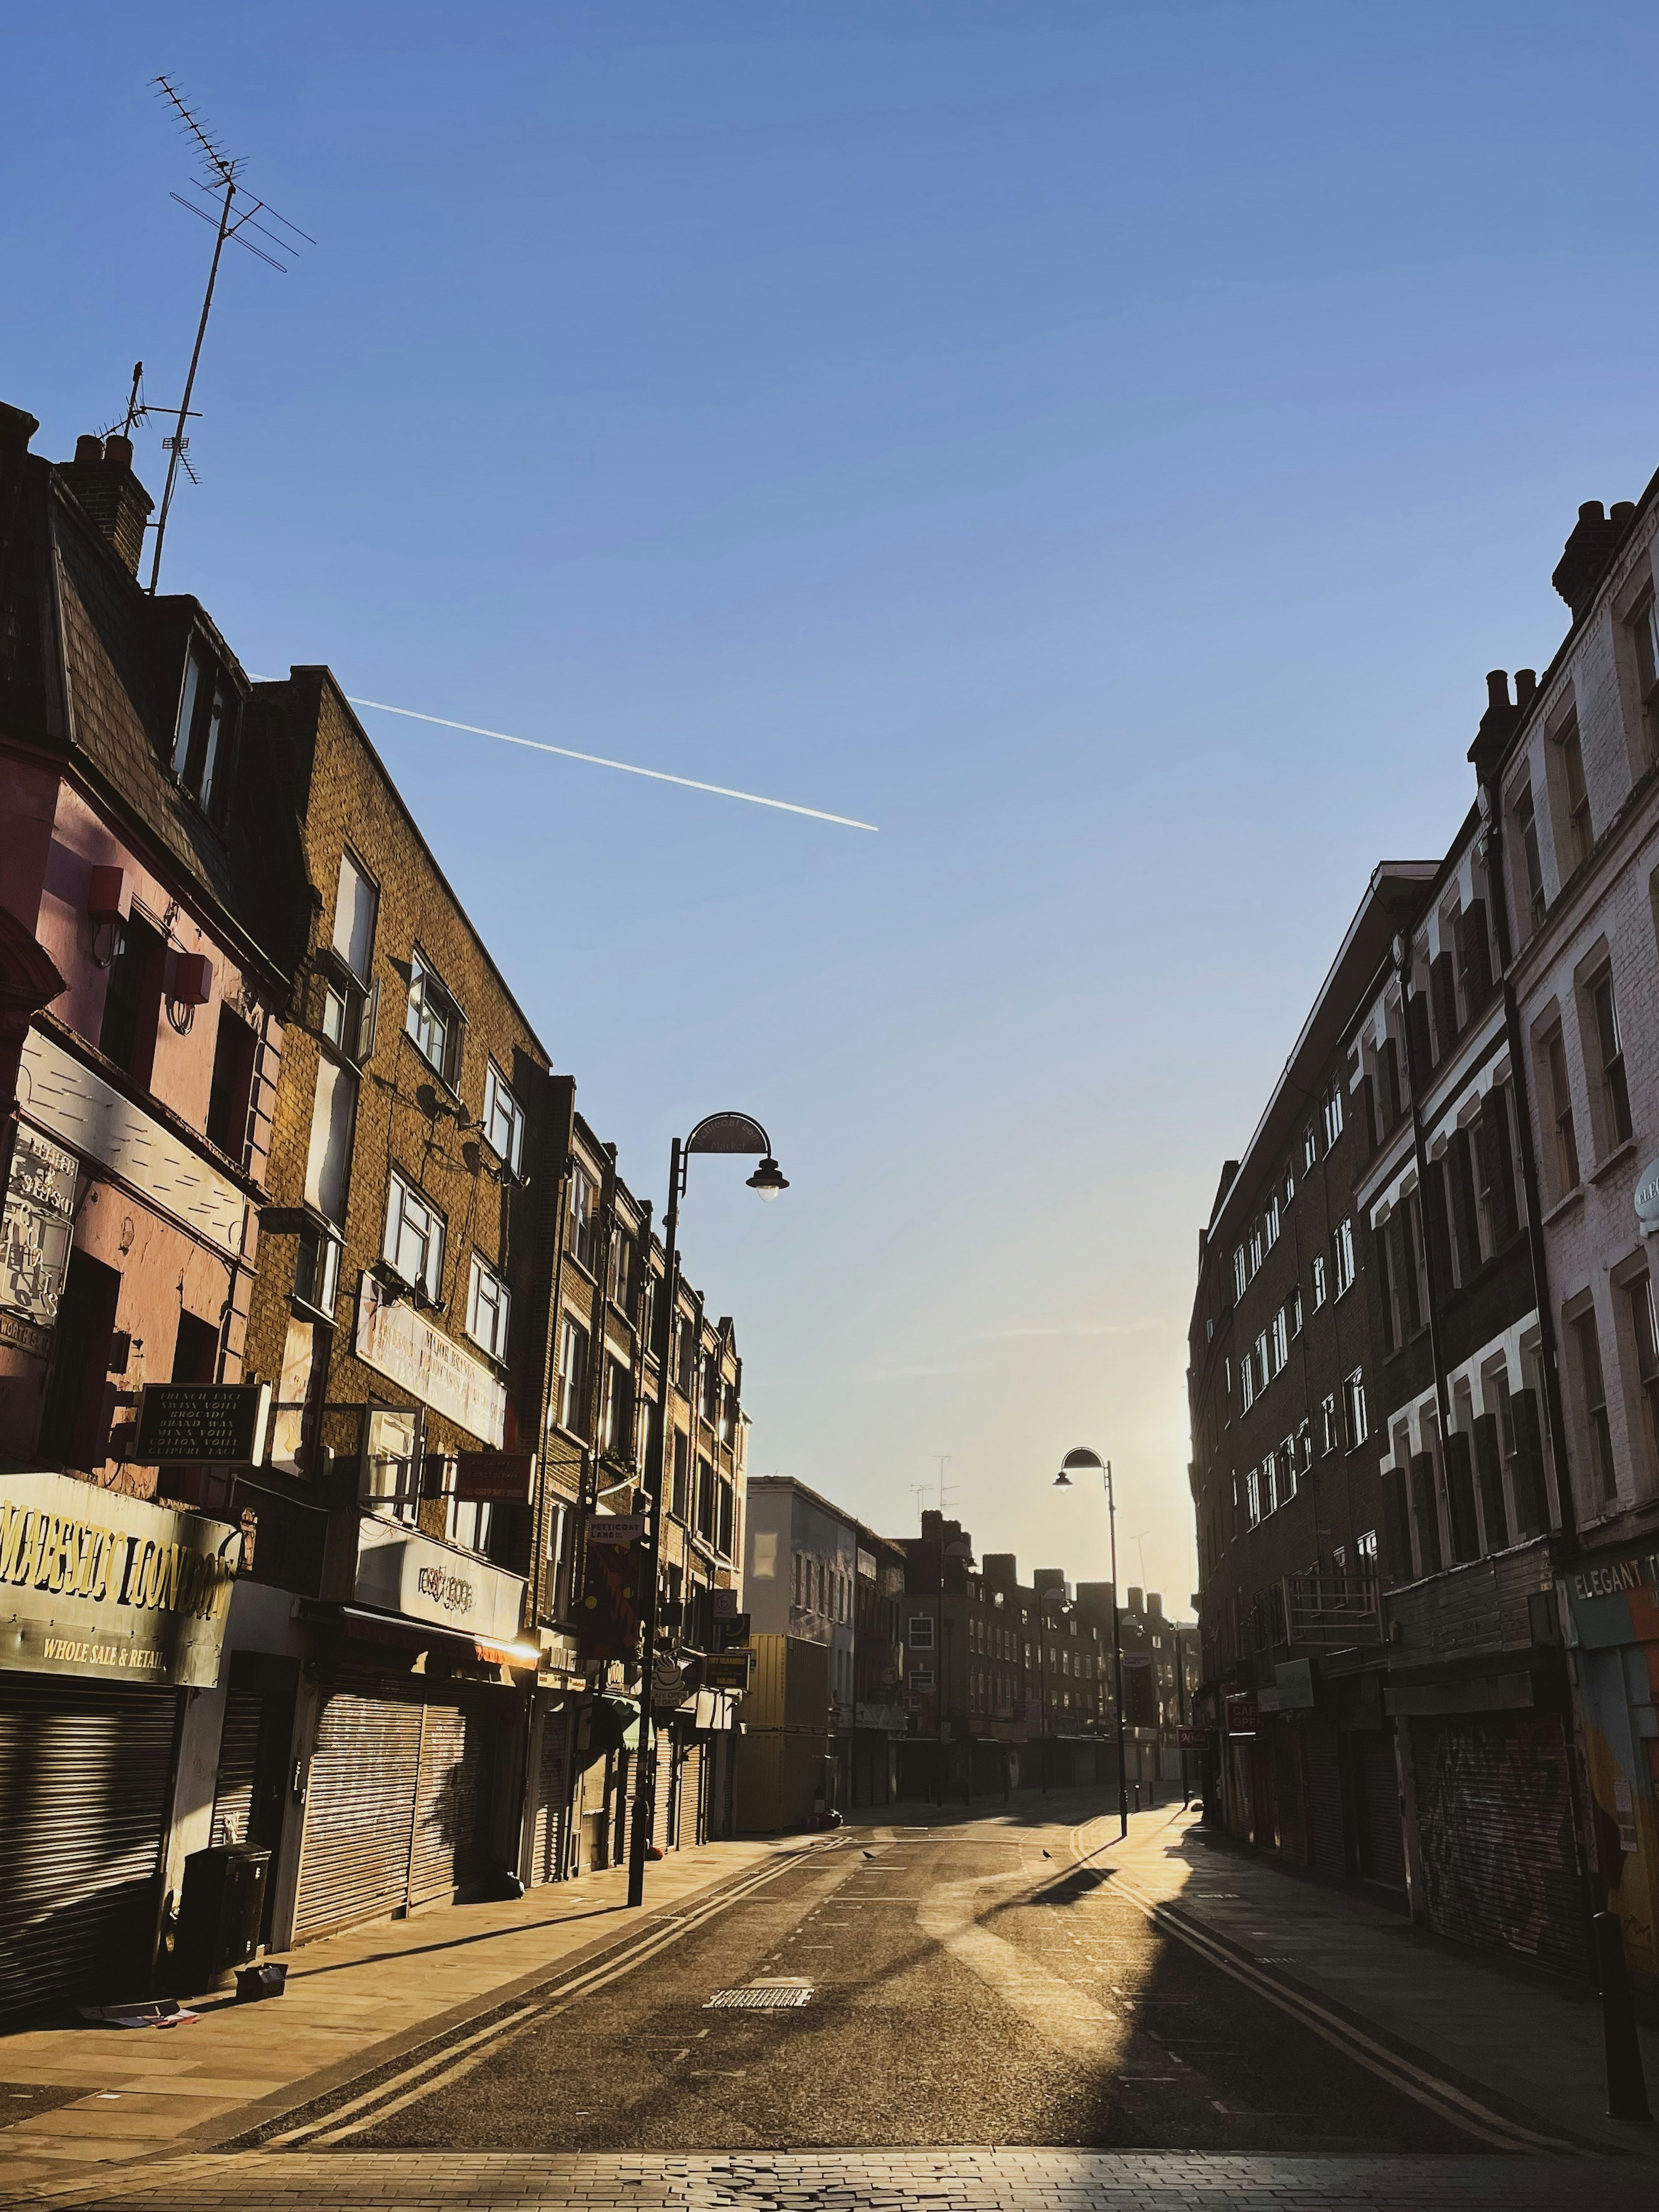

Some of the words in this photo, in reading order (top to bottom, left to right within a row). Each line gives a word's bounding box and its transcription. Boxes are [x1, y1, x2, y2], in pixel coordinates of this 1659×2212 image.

[33, 1138, 75, 1176] LEATHER
[22, 1175, 74, 1216] SHEEPSKIN
[160, 1392, 207, 1401] FRENCH
[0, 1500, 129, 1601] MAJESTIC
[1574, 1559, 1643, 1600] ELEGANT
[1645, 1553, 1659, 1582] T
[43, 1638, 88, 1663] WHOLE
[89, 1644, 118, 1666] SALE
[118, 1647, 129, 1667] &
[130, 1649, 163, 1669] RETAIL
[1233, 1717, 1265, 1727] OPEN
